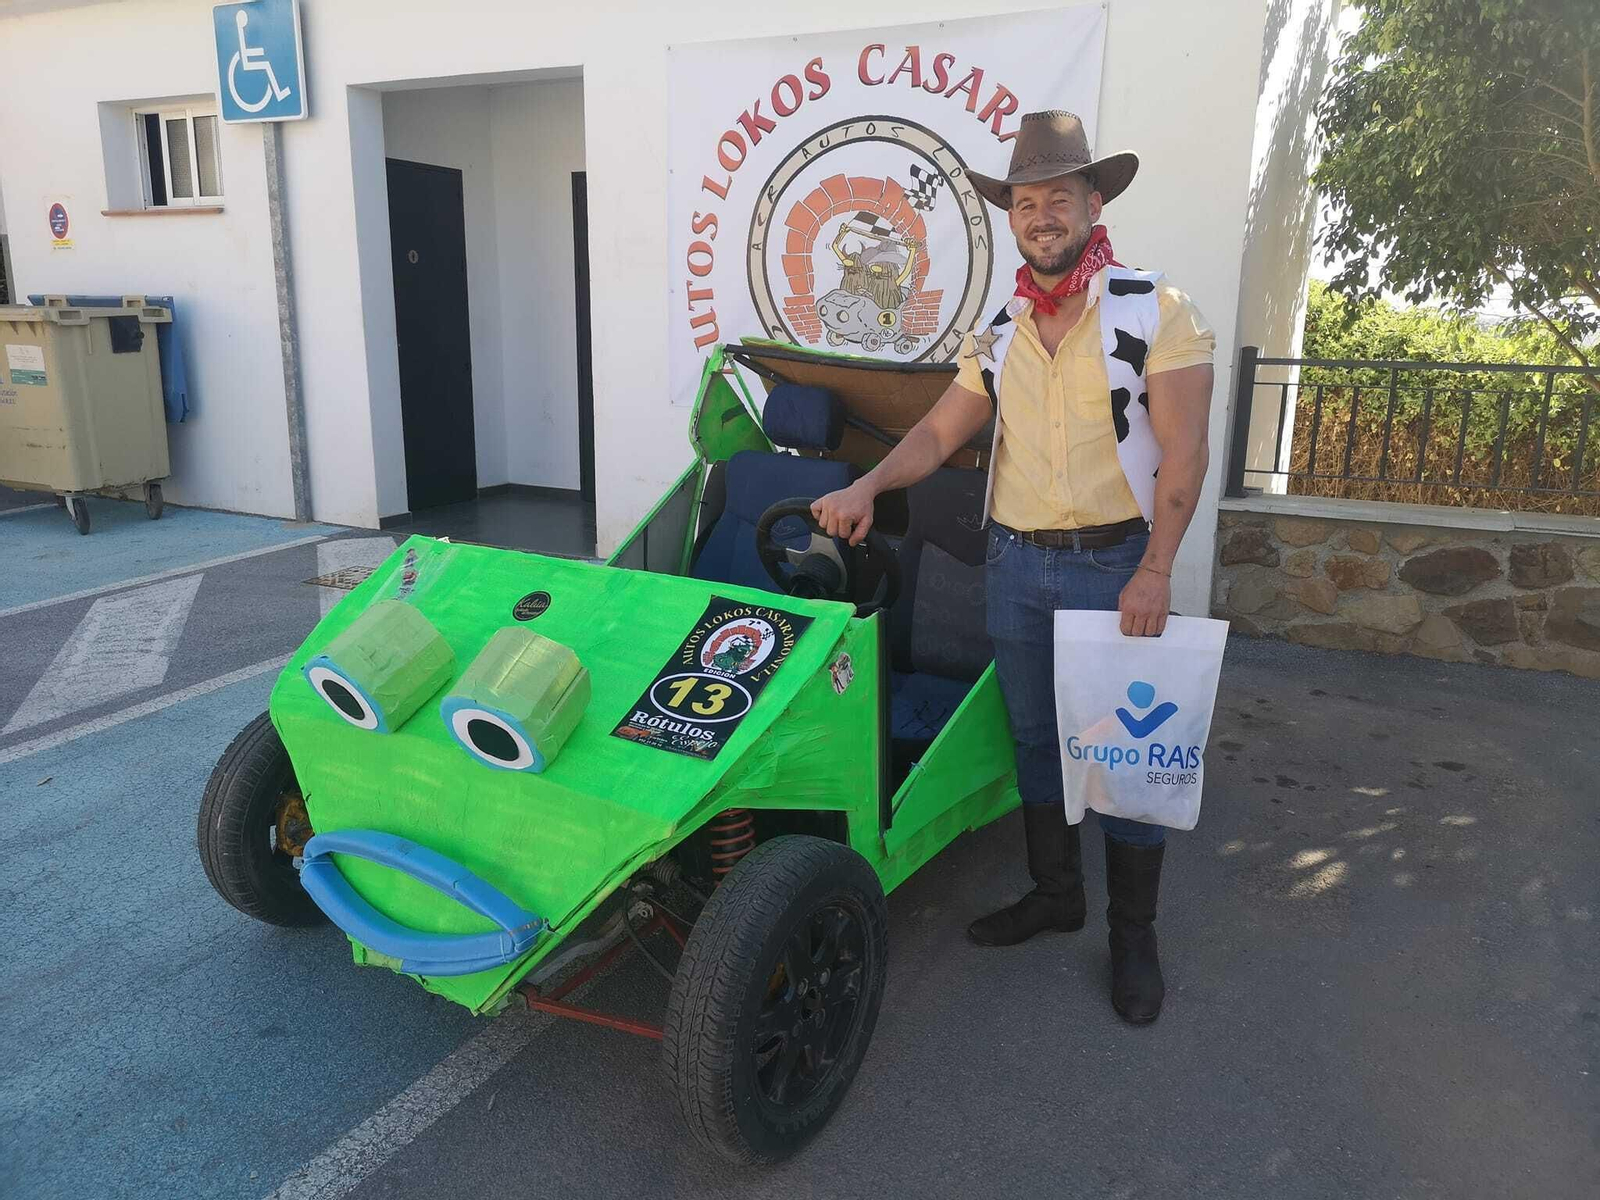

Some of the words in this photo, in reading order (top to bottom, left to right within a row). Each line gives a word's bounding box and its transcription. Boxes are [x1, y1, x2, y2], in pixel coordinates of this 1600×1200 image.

[857, 43, 1023, 143] CASAR
[701, 56, 832, 201] LOKOS
[802, 121, 906, 158] AUTOS
[932, 146, 987, 250] LOKOS
[686, 210, 719, 353] UTOS
[882, 312, 892, 325] 1
[682, 628, 706, 665] AUTOS
[705, 606, 752, 629] LOKOS
[668, 676, 734, 715] 13
[629, 710, 716, 742] Rótulos
[1067, 736, 1140, 770] Grupo
[1148, 743, 1201, 770] RAIS
[1146, 771, 1197, 786] SEGUROS
